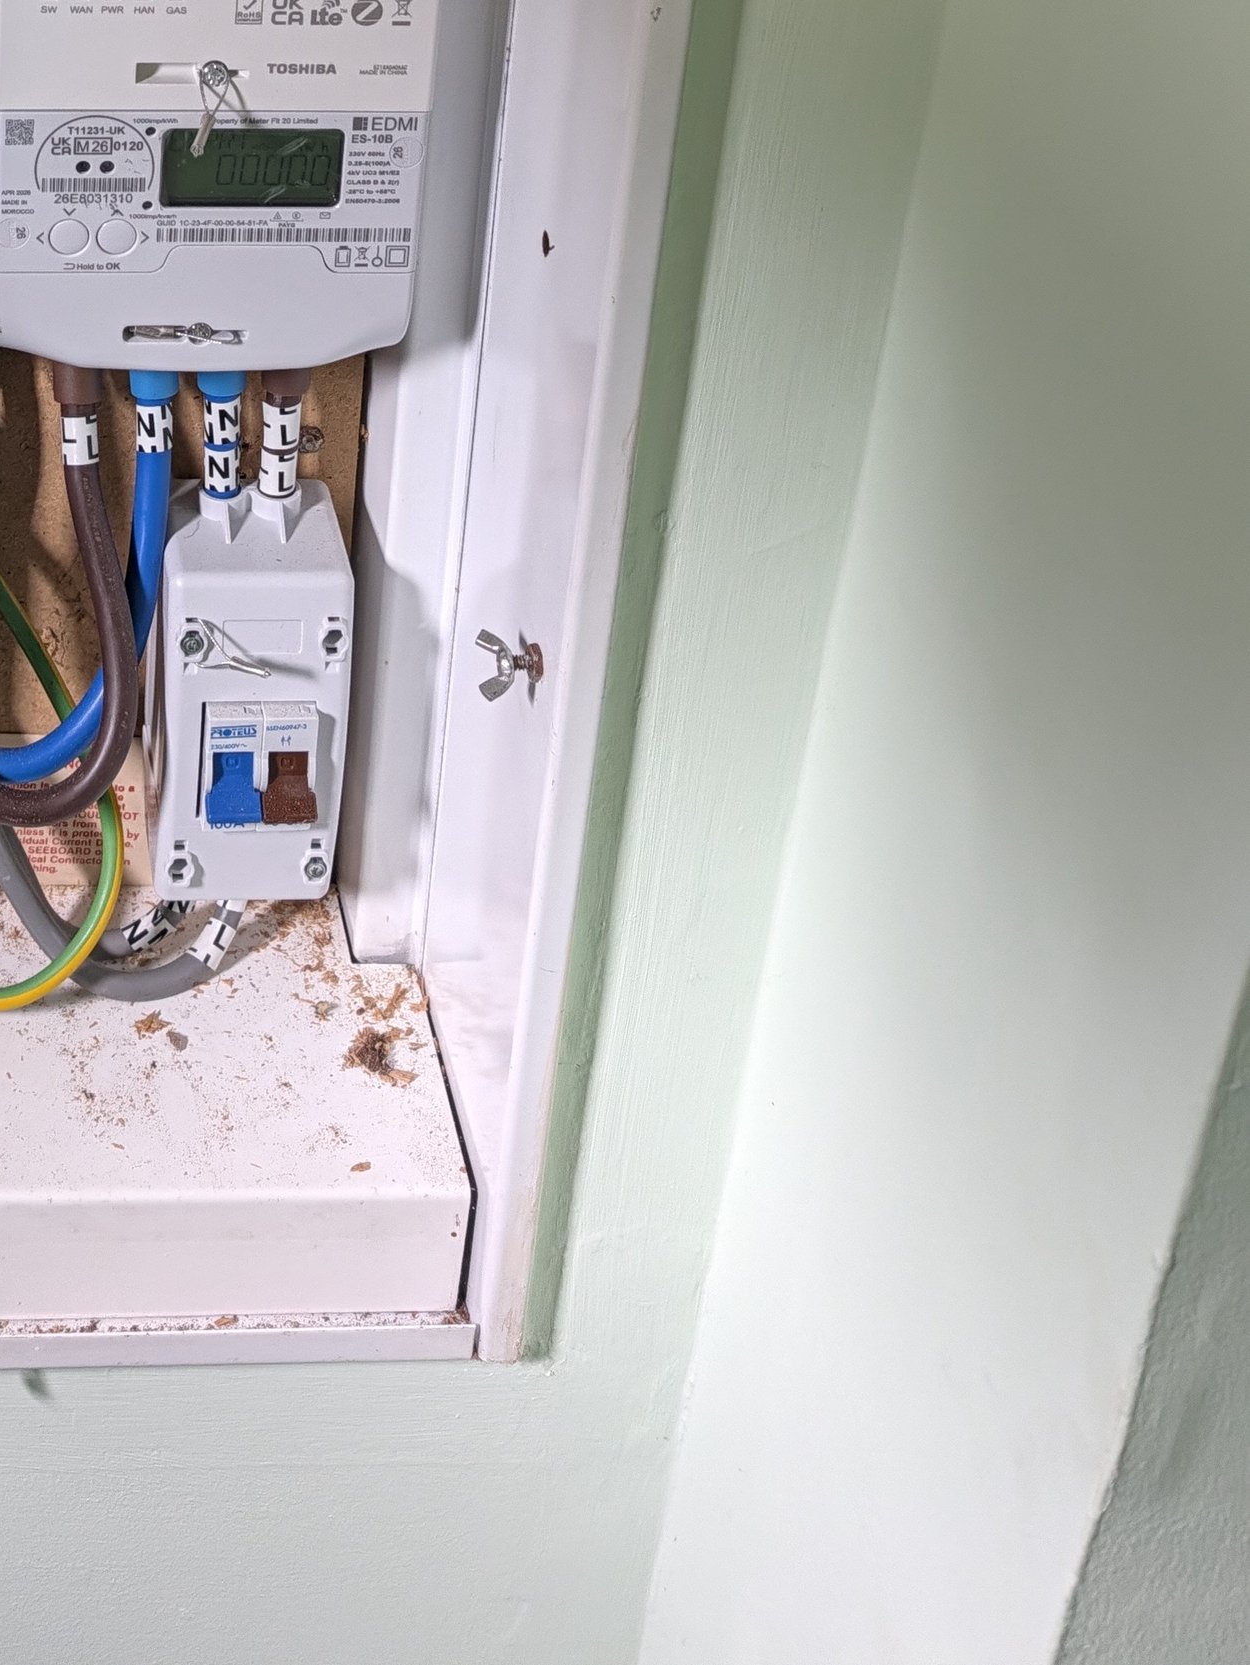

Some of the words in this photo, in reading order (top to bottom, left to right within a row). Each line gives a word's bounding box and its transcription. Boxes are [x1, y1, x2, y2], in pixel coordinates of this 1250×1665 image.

[40, 6, 58, 14] SW
[70, 6, 93, 14] WAN
[101, 6, 124, 14] PWR
[134, 6, 155, 15] HAN
[166, 6, 187, 15] GAS
[271, 11, 304, 26] CA
[267, 63, 337, 75] TOSHIBA
[371, 117, 418, 131] EDMI
[67, 126, 125, 135] T11231-UK
[51, 137, 71, 146] UK
[114, 141, 144, 151] 0120
[351, 134, 393, 143] ES-10B
[51, 147, 71, 155] CA
[54, 194, 133, 204] 26E8031310
[219, 405, 238, 431] N
[138, 413, 155, 438] N
[281, 425, 297, 447] L
[209, 455, 229, 480] N
[279, 472, 294, 493] L
[210, 727, 257, 737] PROTEUS
[127, 831, 140, 840] by
[52, 838, 93, 846] Current
[28, 846, 91, 855] SEEBOARD
